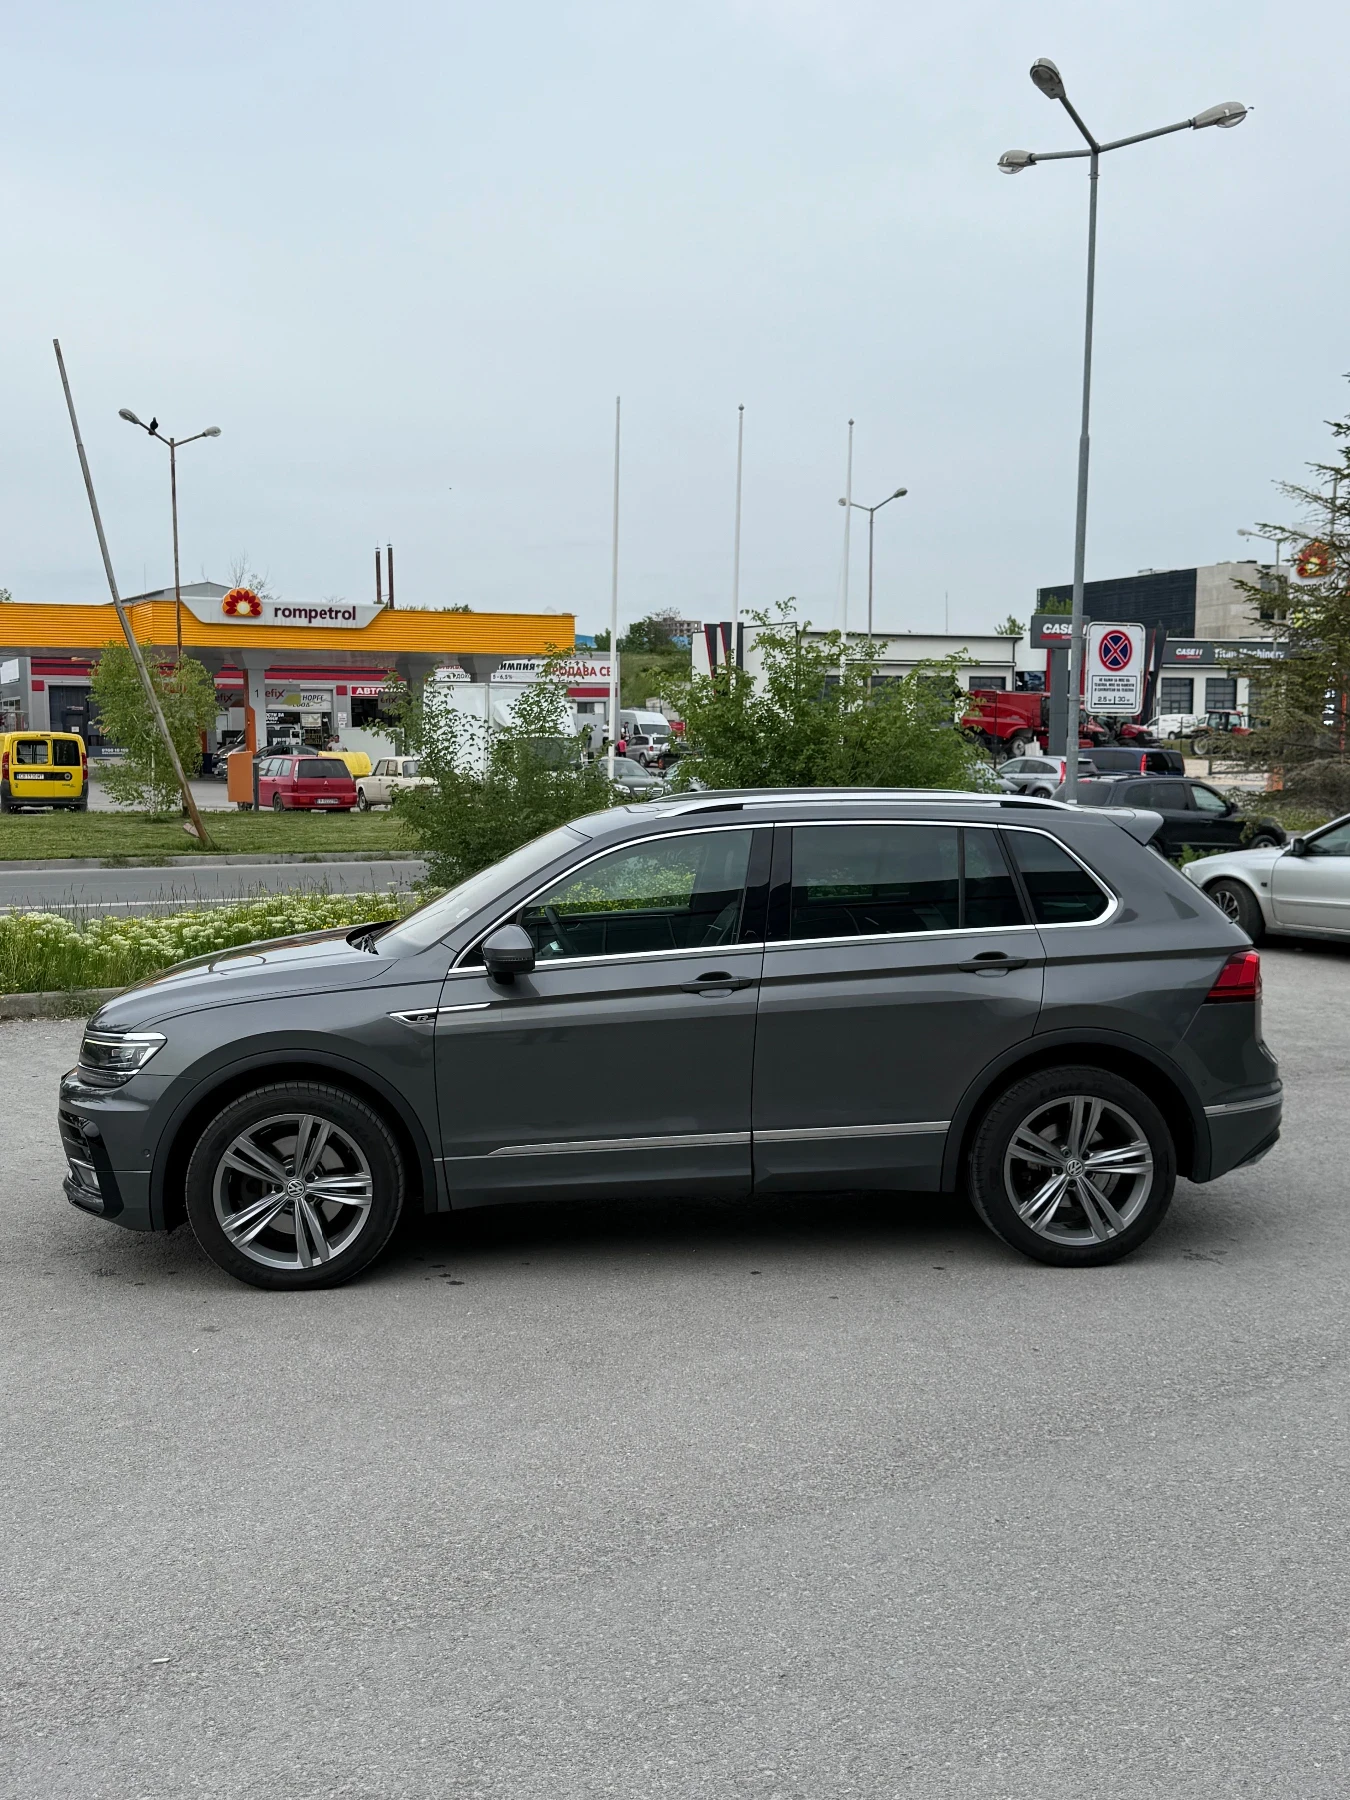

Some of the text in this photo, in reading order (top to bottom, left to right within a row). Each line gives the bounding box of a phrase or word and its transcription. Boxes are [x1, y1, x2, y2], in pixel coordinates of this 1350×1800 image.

[274, 605, 356, 623] rompetrol
[1175, 648, 1196, 656] CASE
[498, 662, 536, 671] ИМПИЯ
[551, 666, 597, 678] РОДАВА
[254, 689, 259, 698] 1
[265, 688, 286, 700] efix
